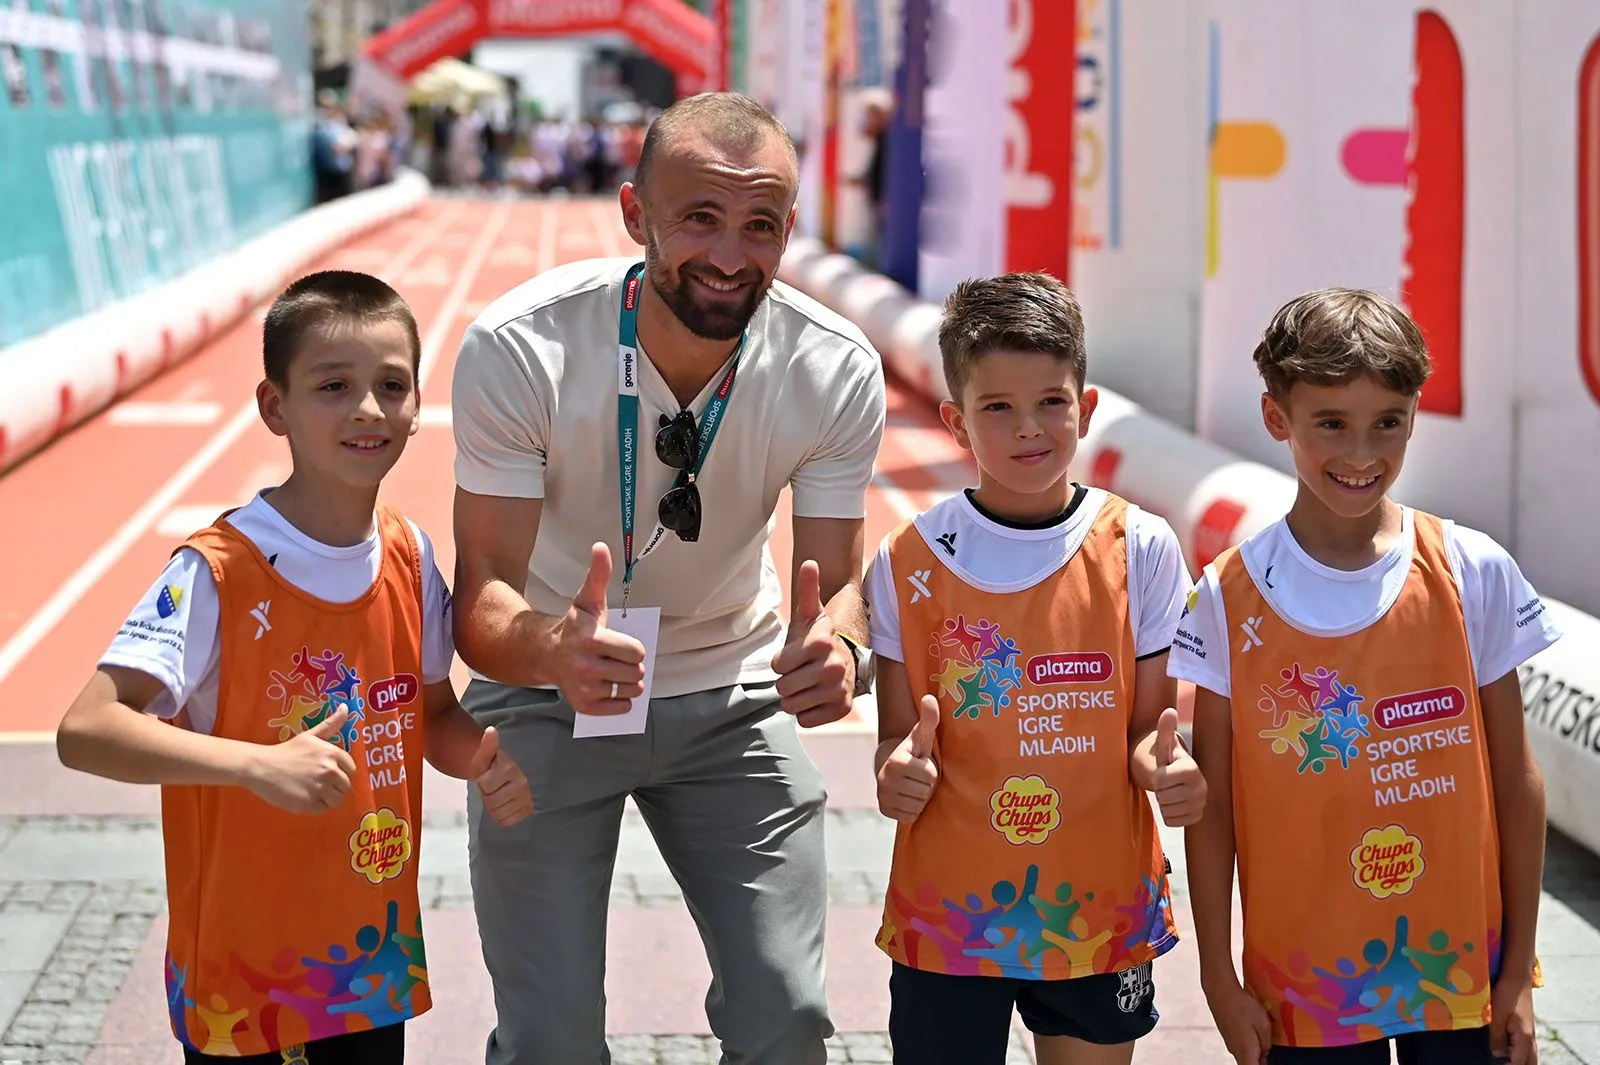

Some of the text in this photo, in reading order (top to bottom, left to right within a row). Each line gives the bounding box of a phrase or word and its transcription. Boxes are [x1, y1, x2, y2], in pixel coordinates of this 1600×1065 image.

[626, 280, 637, 309] plazma
[623, 353, 634, 388] gorenje
[699, 400, 722, 442] SPORTSKE
[624, 428, 633, 529] SPORTSKE IGRE MLADIH
[1035, 659, 1102, 682] plazma
[1017, 690, 1116, 713] SPORTSKE
[1382, 694, 1454, 726] plazma
[1018, 714, 1064, 735] IGRE
[1019, 735, 1096, 757] MLADIH
[1366, 725, 1473, 762] SPORTSKE
[1370, 759, 1419, 784] IGRE
[998, 791, 1053, 813] Chupa
[1375, 775, 1456, 808] MLADIH
[357, 824, 404, 848] Chupa
[996, 809, 1052, 837] Chups
[356, 841, 404, 874] Chups
[1359, 840, 1414, 864] Chupa
[1359, 858, 1415, 890] Chups
